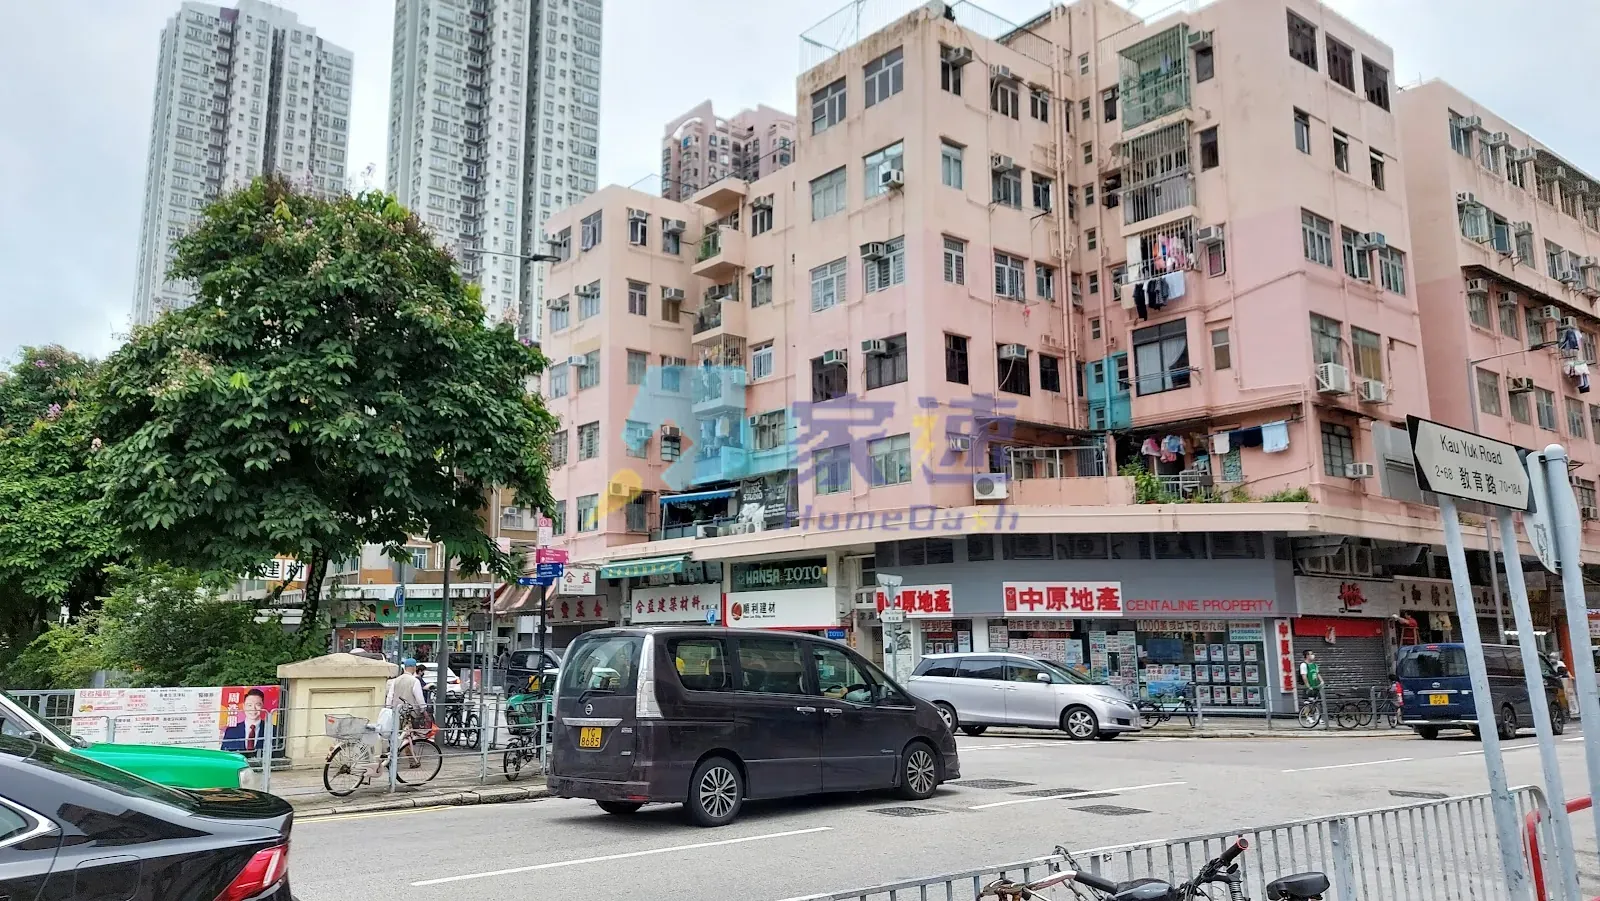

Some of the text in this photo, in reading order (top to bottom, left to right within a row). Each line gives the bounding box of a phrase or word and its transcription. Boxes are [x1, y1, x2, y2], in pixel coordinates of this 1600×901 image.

[1439, 433, 1503, 465] Kau Yuk Road
[1434, 464, 1454, 481] 2-68
[743, 492, 763, 501] STUDIO
[746, 565, 821, 584] HANSA TOTO
[635, 595, 700, 614] 合益建築材料
[1019, 586, 1121, 612] 中原地產
[1126, 600, 1274, 612] CENTALINE PROPERTY
[743, 602, 775, 613] 順利建材
[585, 728, 596, 737] YG
[580, 737, 600, 747] 8685
